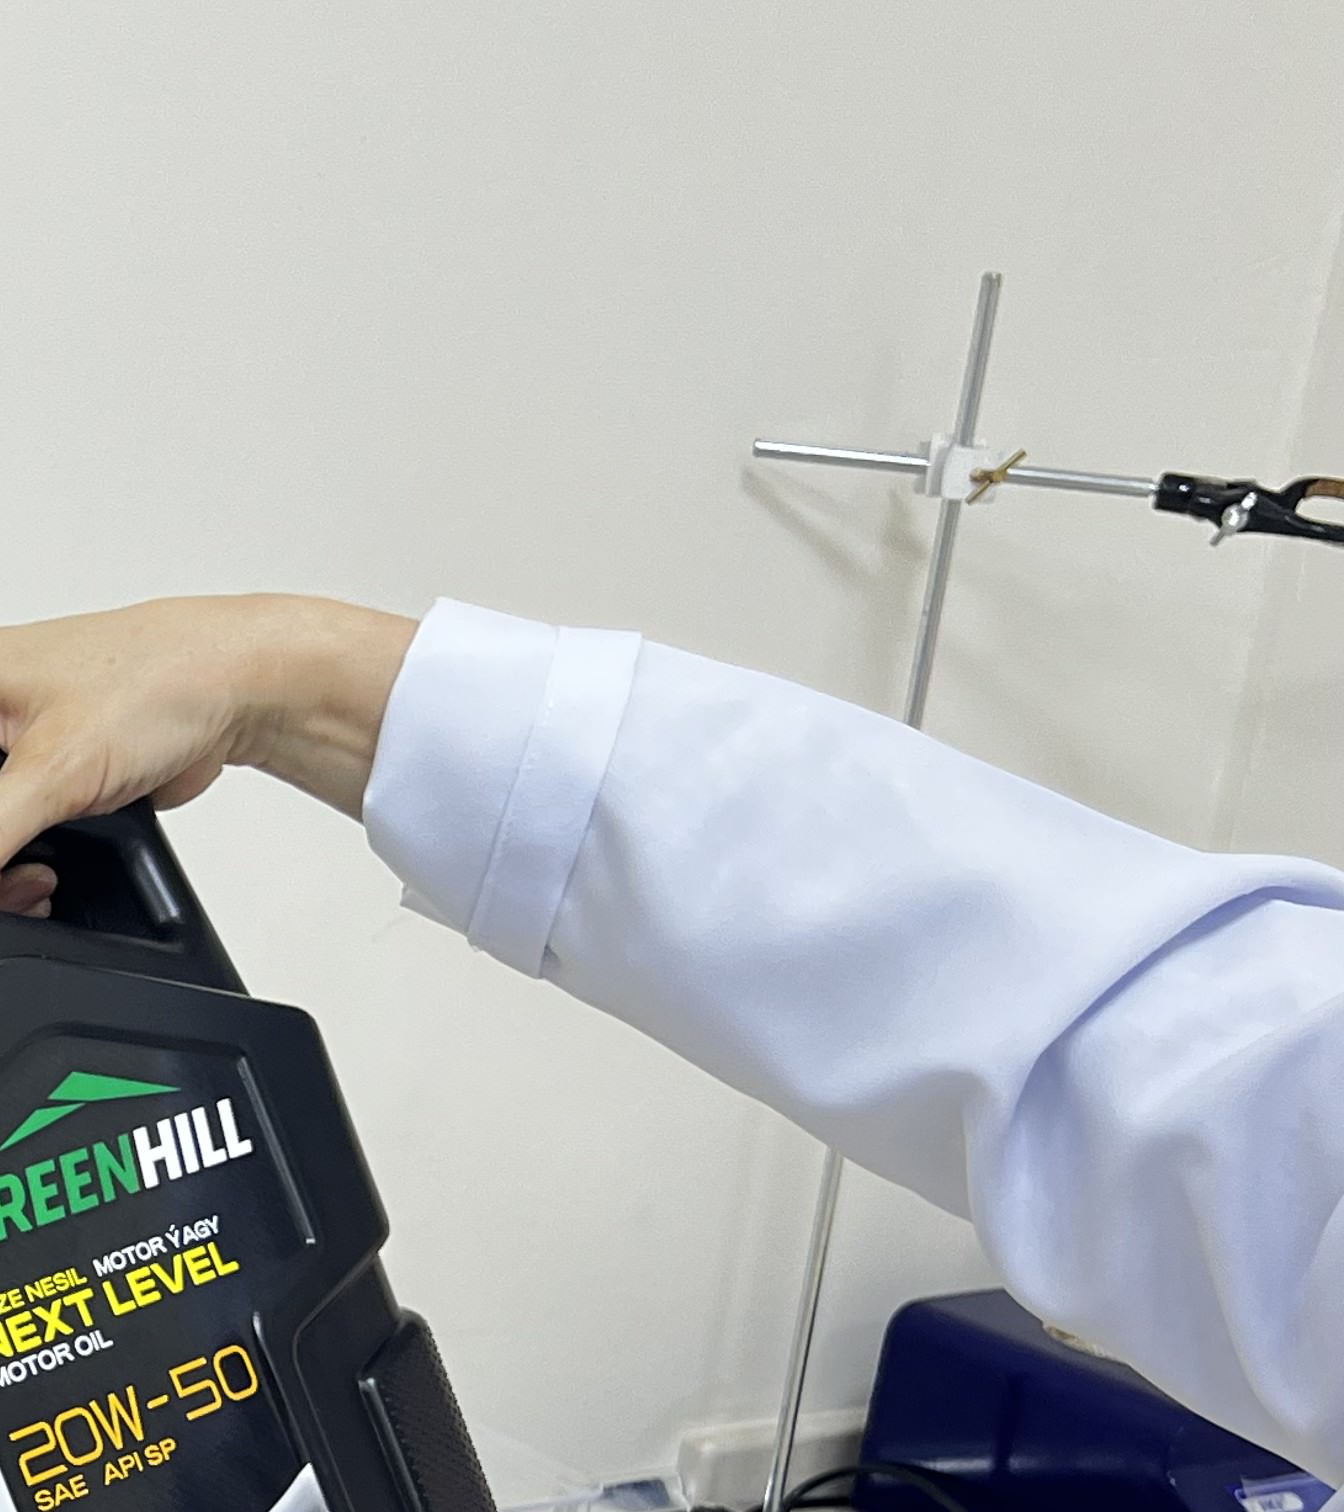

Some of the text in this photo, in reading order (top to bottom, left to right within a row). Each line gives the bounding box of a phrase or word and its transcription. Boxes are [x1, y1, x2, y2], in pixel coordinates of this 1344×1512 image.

[24, 1267, 88, 1302] NESIL
[92, 1239, 167, 1277] MOTOR
[168, 1215, 221, 1249] ÝAGY
[102, 1240, 240, 1317] LEVEL
[77, 1330, 113, 1357] OIL
[9, 1344, 259, 1487] 20W-50
[34, 1437, 177, 1512] SAE API SP
